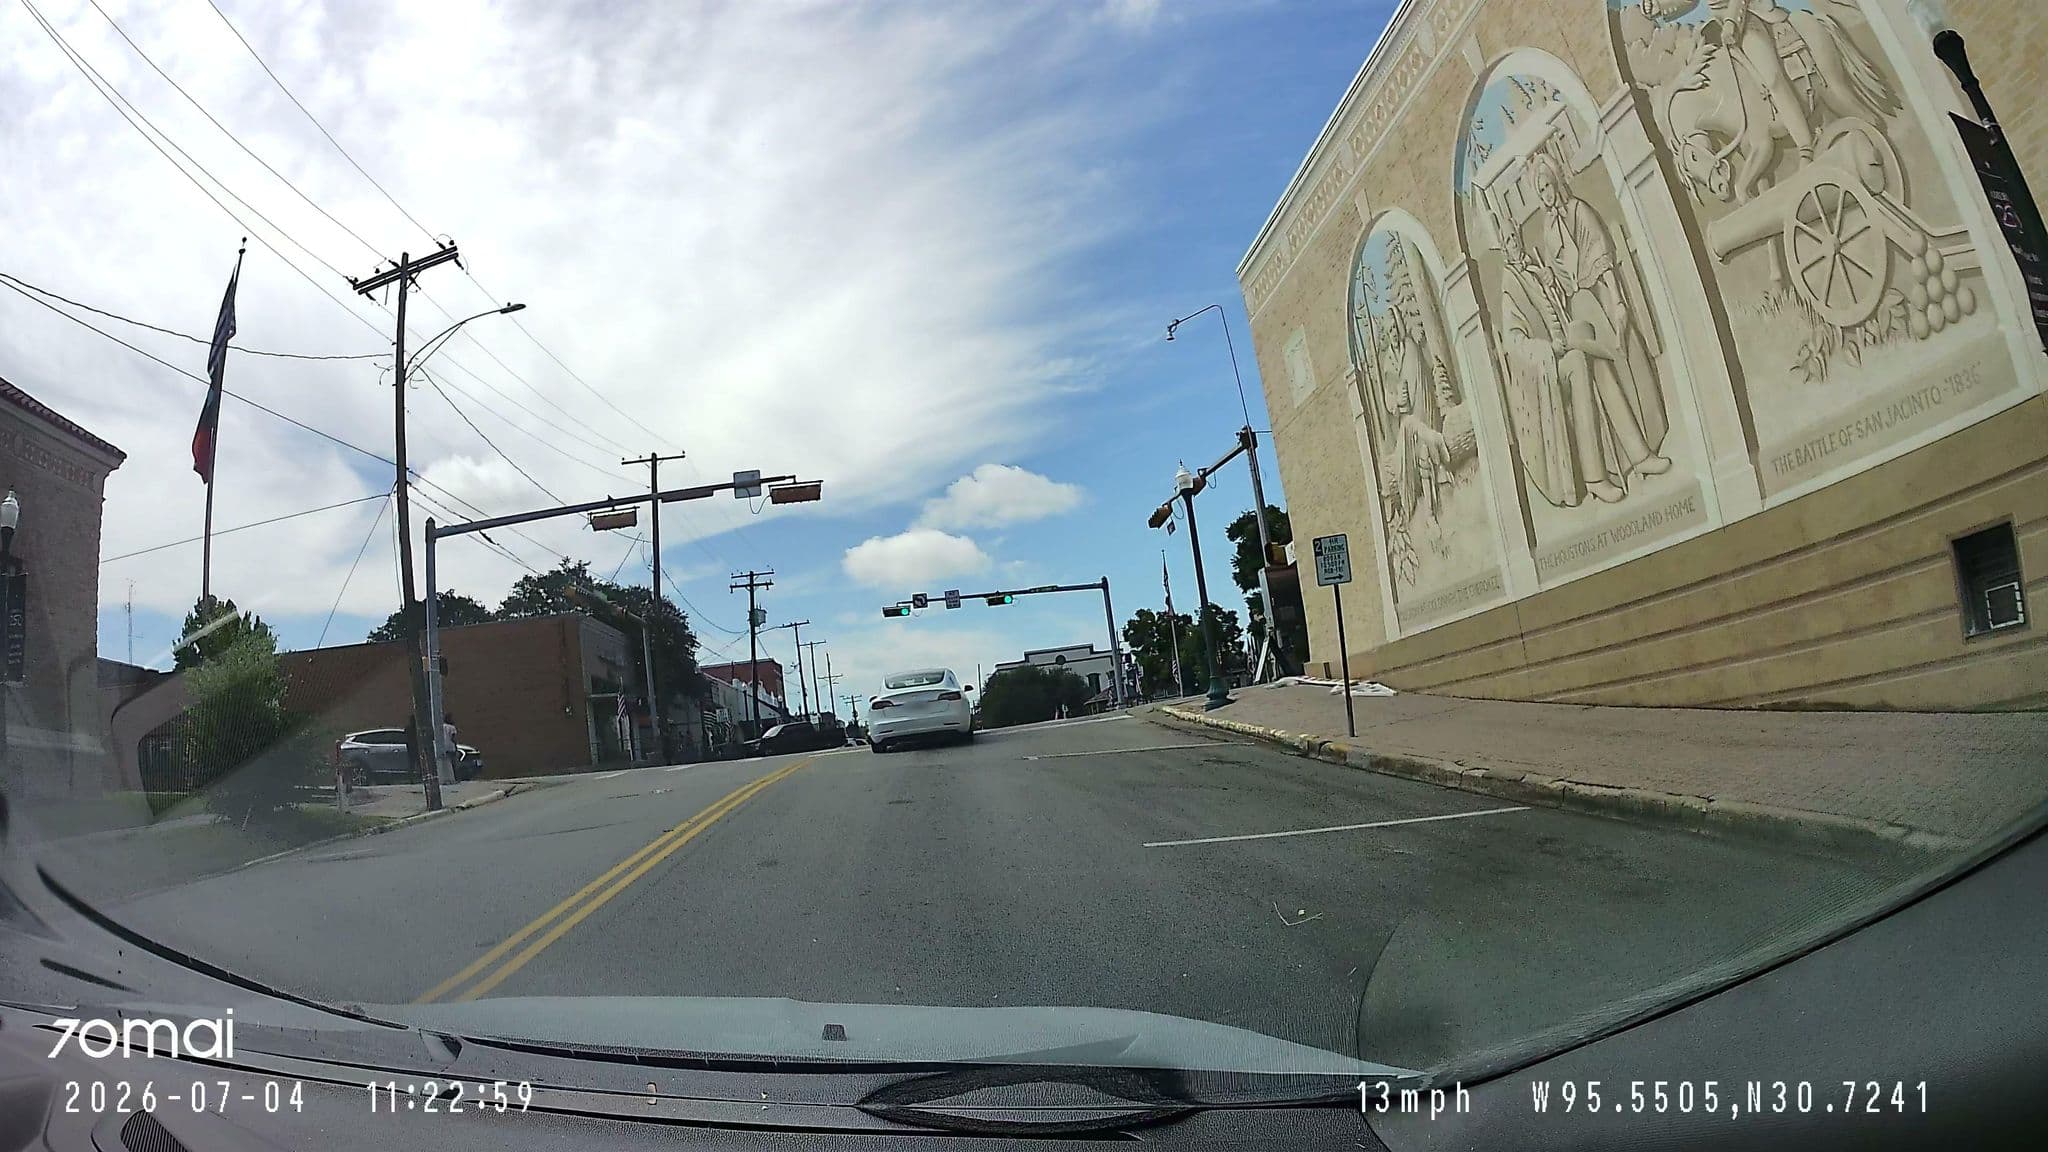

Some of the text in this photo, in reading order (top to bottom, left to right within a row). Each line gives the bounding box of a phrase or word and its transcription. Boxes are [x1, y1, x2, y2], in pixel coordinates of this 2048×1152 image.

[1773, 455, 1794, 476] THE
[1793, 434, 1838, 465] BATTLE
[1839, 425, 1855, 446] OF
[1856, 413, 1883, 438] SAN
[1882, 387, 1940, 428] JACINTO
[1315, 540, 1321, 552] 2
[1538, 556, 1553, 570] THE
[1596, 532, 1609, 548] AT
[1609, 511, 1664, 543] WOODLAND
[1664, 495, 1696, 520] HOME
